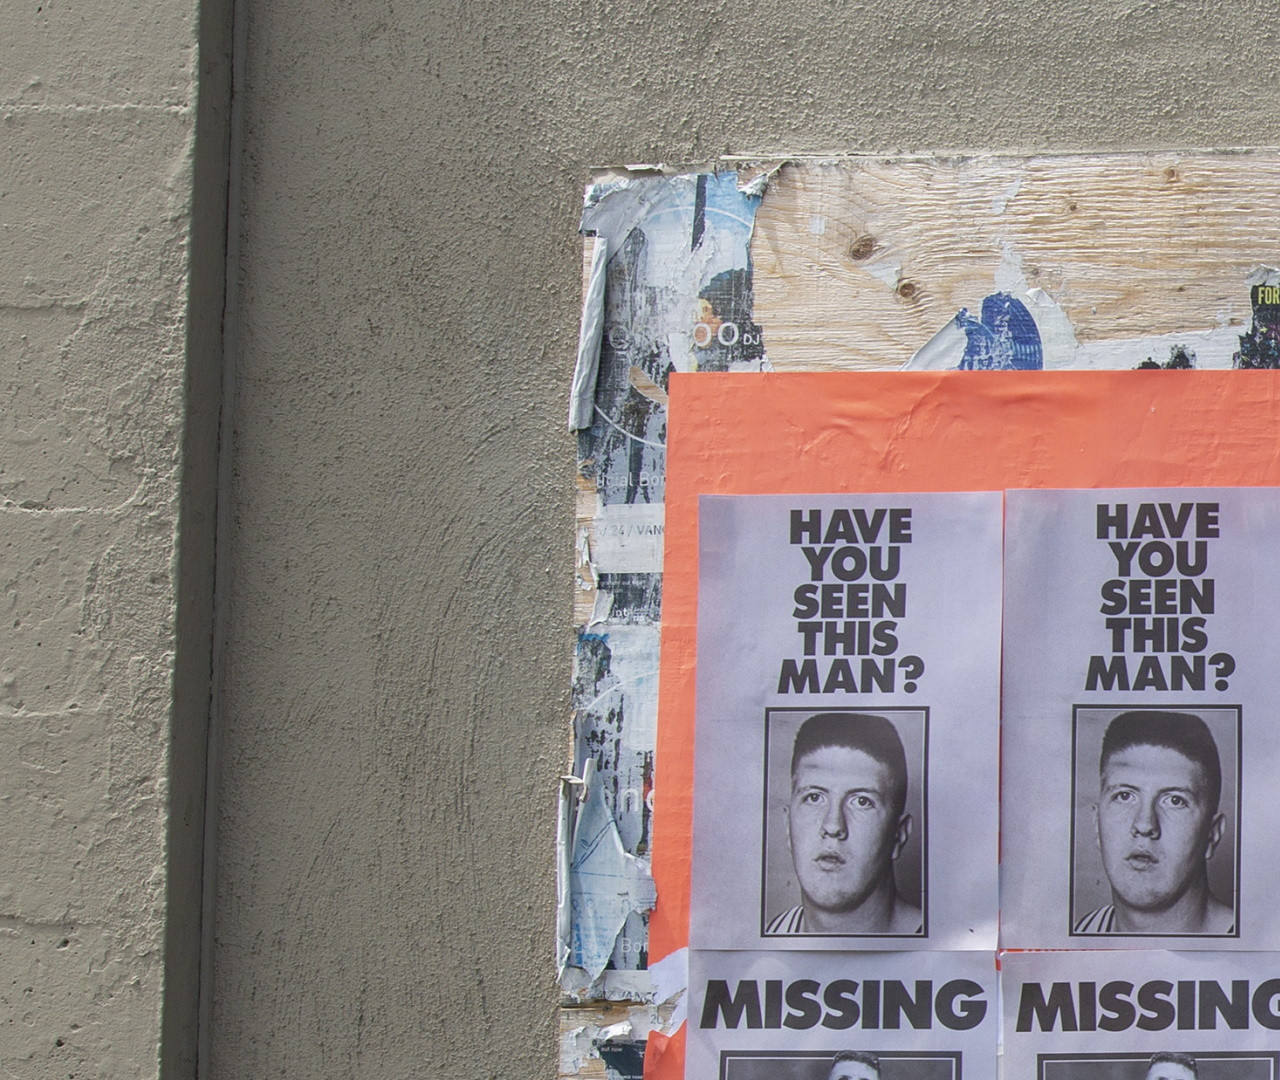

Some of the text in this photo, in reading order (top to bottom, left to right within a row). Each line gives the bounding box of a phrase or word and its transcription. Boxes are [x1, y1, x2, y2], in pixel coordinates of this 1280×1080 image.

[637, 525, 665, 535] VAN
[789, 508, 913, 545] HAVE
[1096, 502, 1220, 540] HAVE
[801, 545, 901, 582] YOU
[1107, 540, 1208, 578] YOU
[792, 583, 907, 620] SEEN
[1099, 578, 1215, 616] SEEN
[797, 620, 899, 656] THIS
[1105, 616, 1209, 654] THIS
[777, 655, 925, 695] MAN?
[1084, 652, 1236, 693] MAN?
[699, 978, 988, 1031] MISSING
